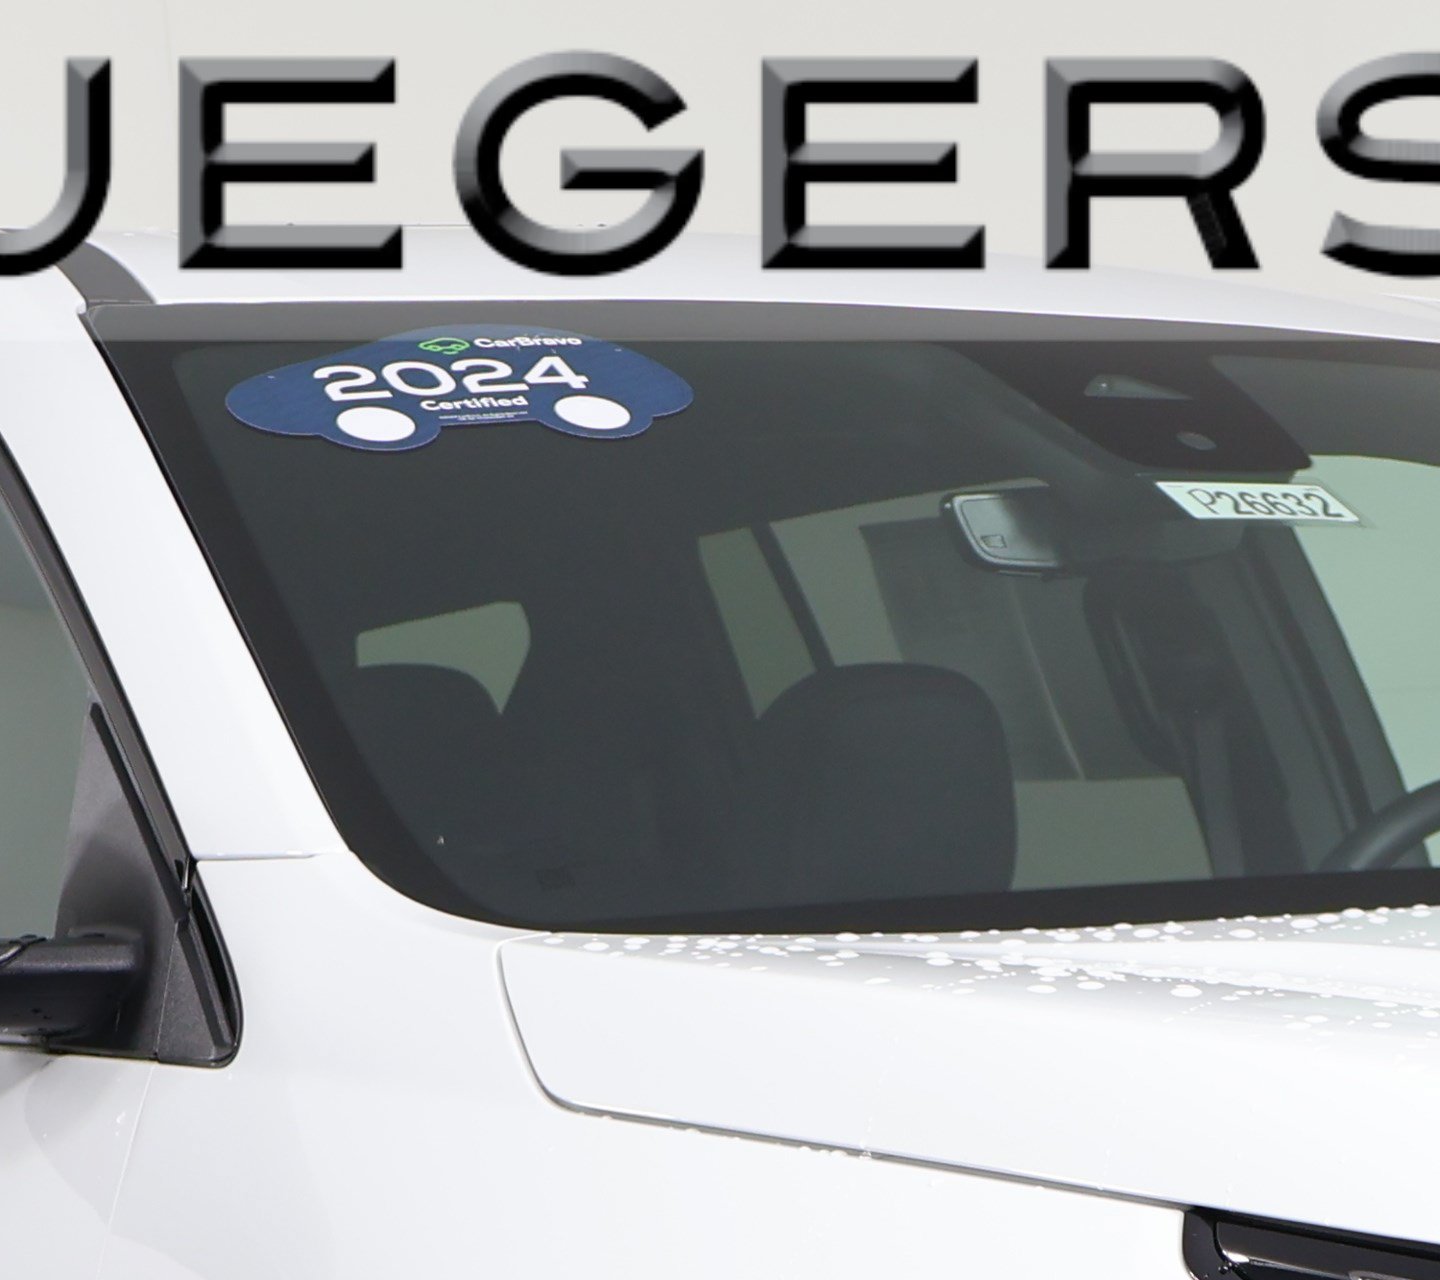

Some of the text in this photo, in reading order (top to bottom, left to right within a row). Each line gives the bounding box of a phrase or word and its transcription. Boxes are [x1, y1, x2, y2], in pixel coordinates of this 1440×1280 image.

[473, 335, 583, 349] CarBravo
[313, 355, 590, 402] 2024
[420, 394, 529, 411] Certified
[1187, 488, 1344, 519] P26632
